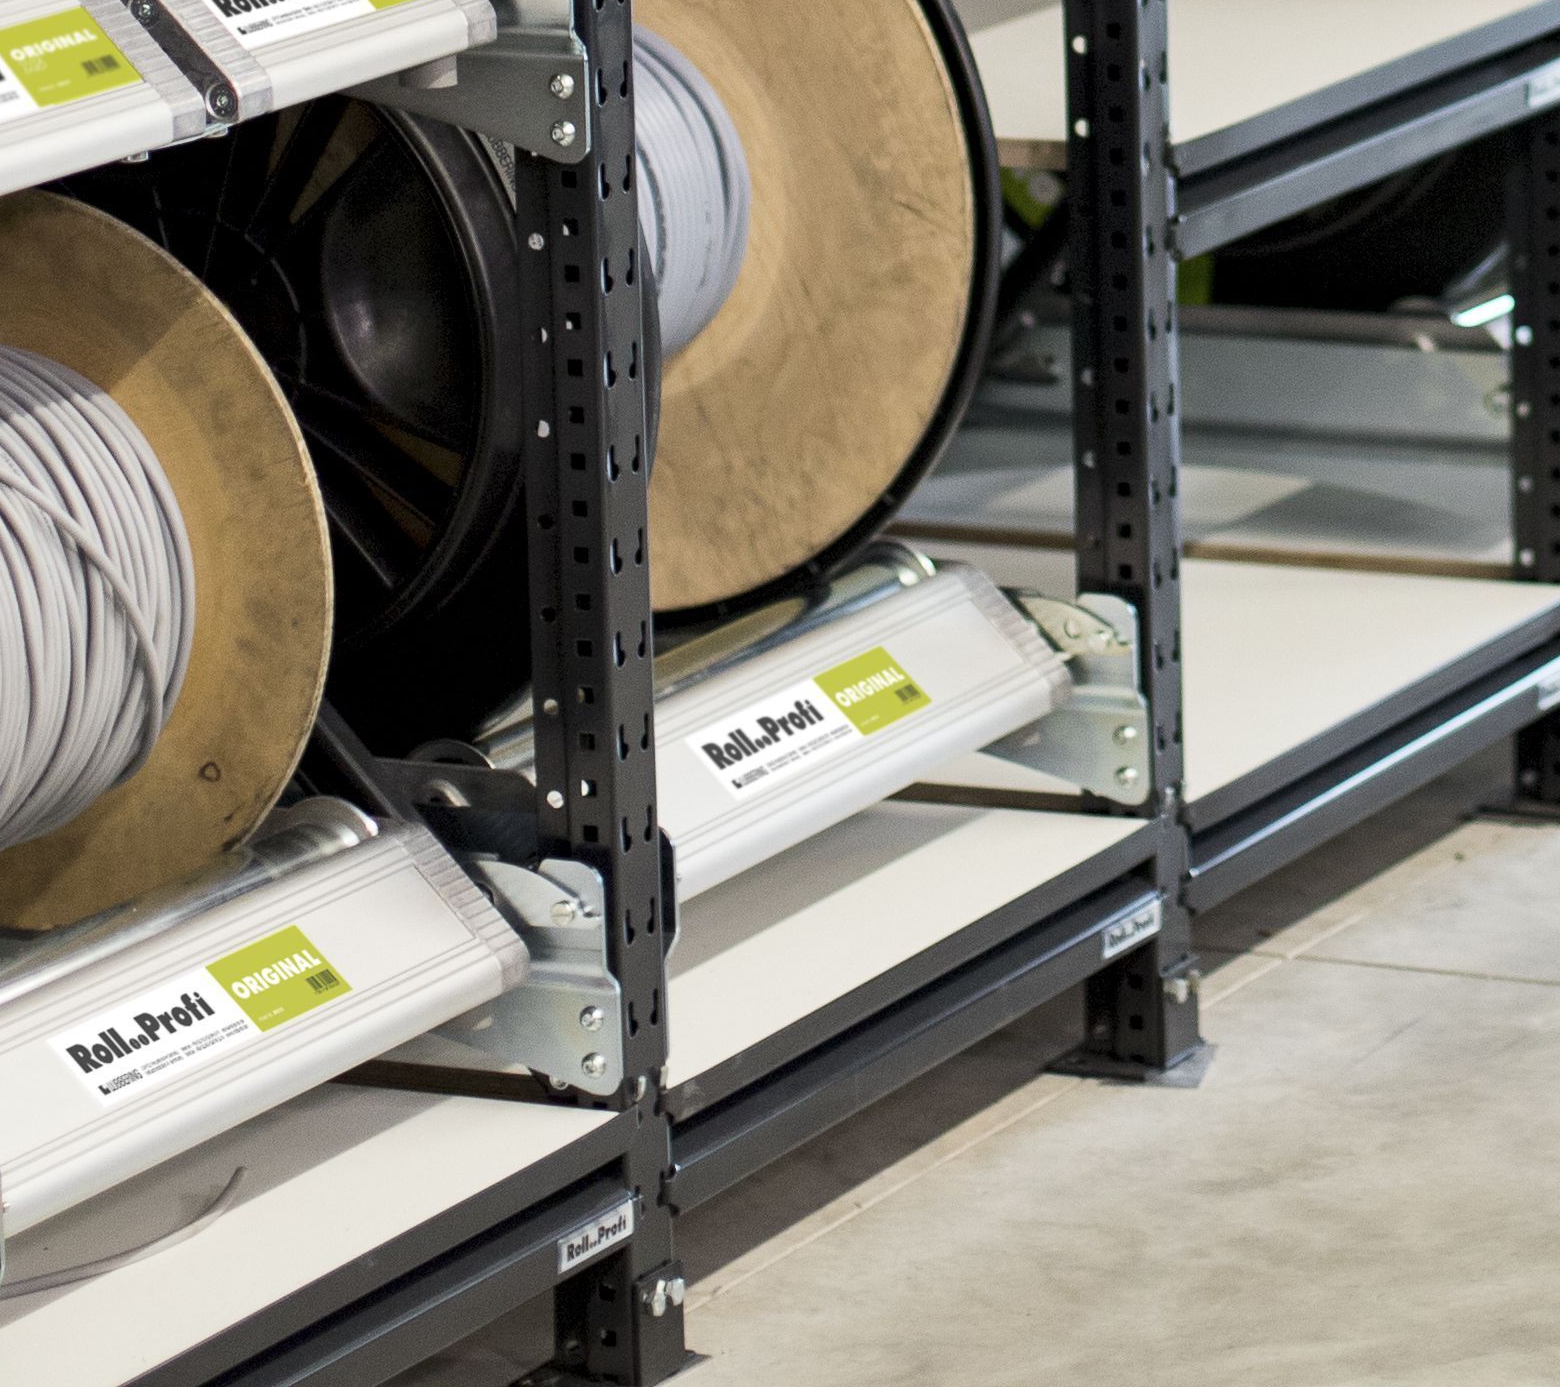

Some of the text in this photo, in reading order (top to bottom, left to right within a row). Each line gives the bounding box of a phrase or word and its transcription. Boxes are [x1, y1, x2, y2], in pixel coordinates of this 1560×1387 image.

[10, 29, 98, 62] ORIGINAL
[835, 667, 905, 708] ORIGINAL
[231, 949, 322, 1000] ORIGINAL
